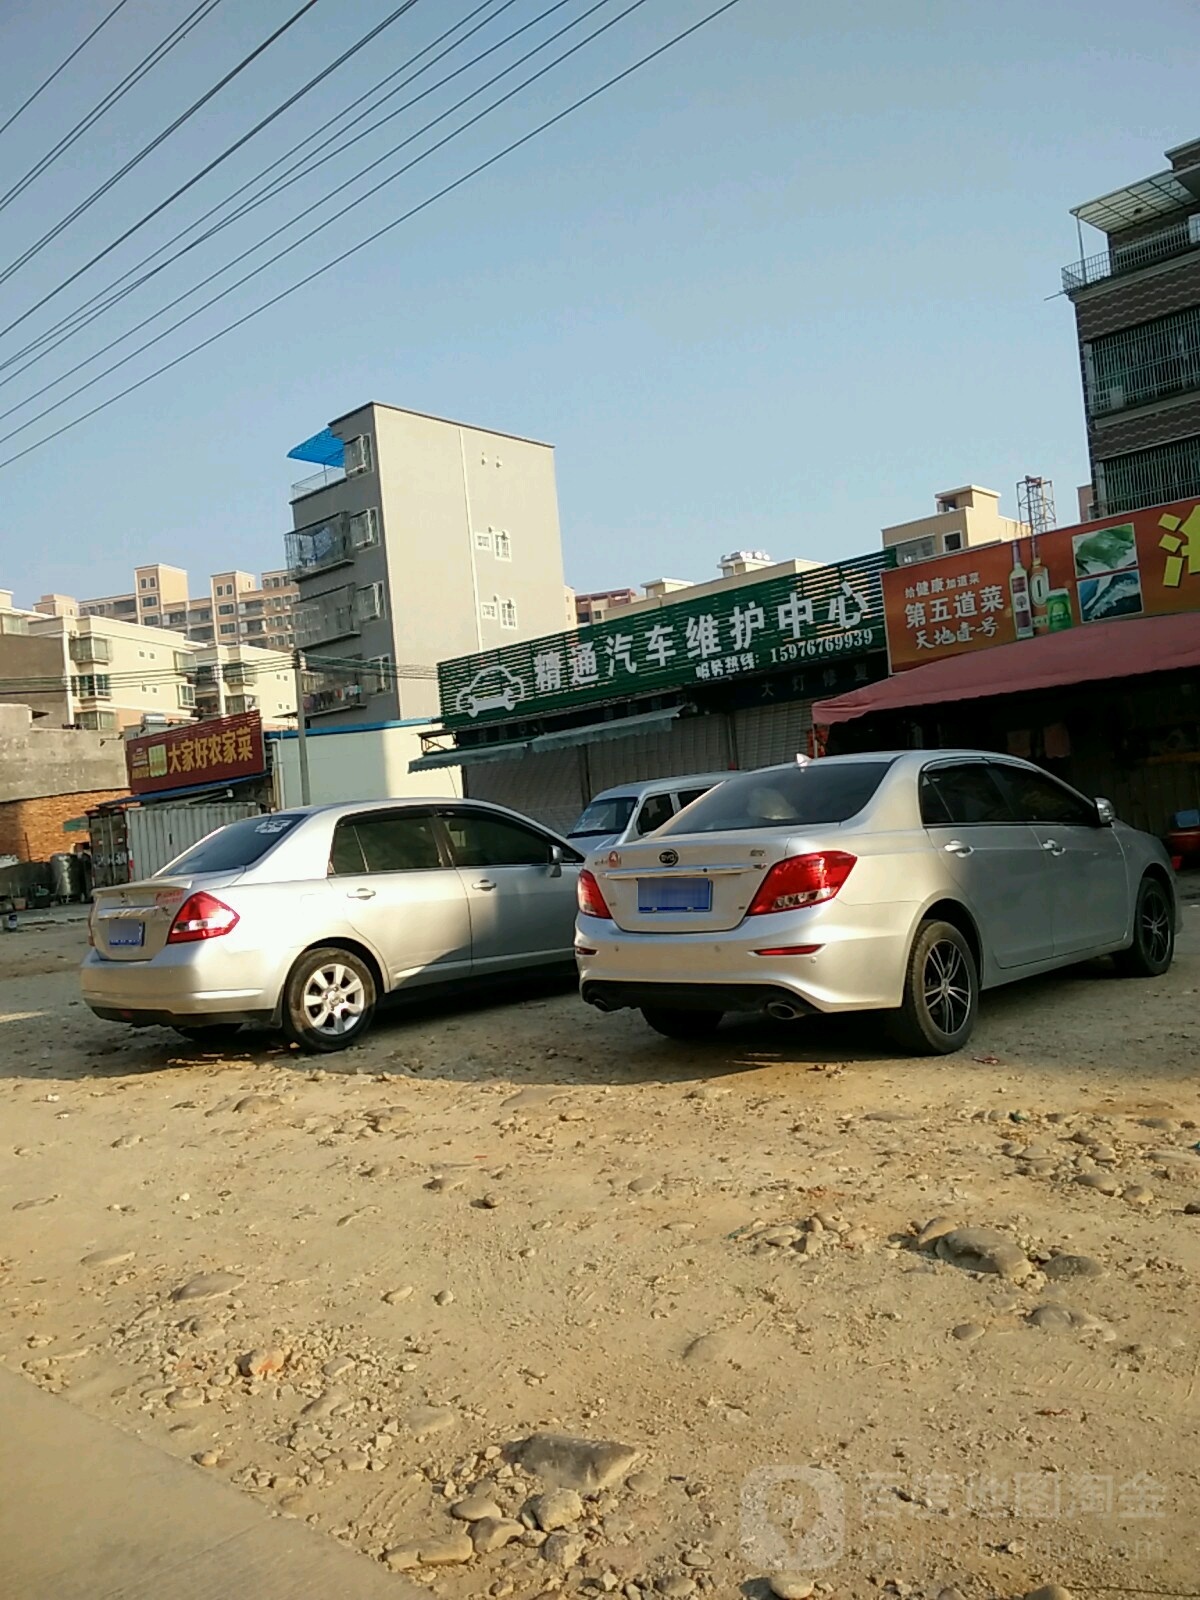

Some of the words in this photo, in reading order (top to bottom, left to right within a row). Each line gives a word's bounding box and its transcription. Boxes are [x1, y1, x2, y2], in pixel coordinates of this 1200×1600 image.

[904, 572, 980, 599] 给健康加道菜
[905, 585, 1004, 629] 第五道菜
[533, 581, 870, 692] 精通汽车维护中心
[769, 629, 873, 663] 15976769939
[916, 616, 1000, 650] 天地壹号
[168, 726, 253, 775] 大家好农家菜
